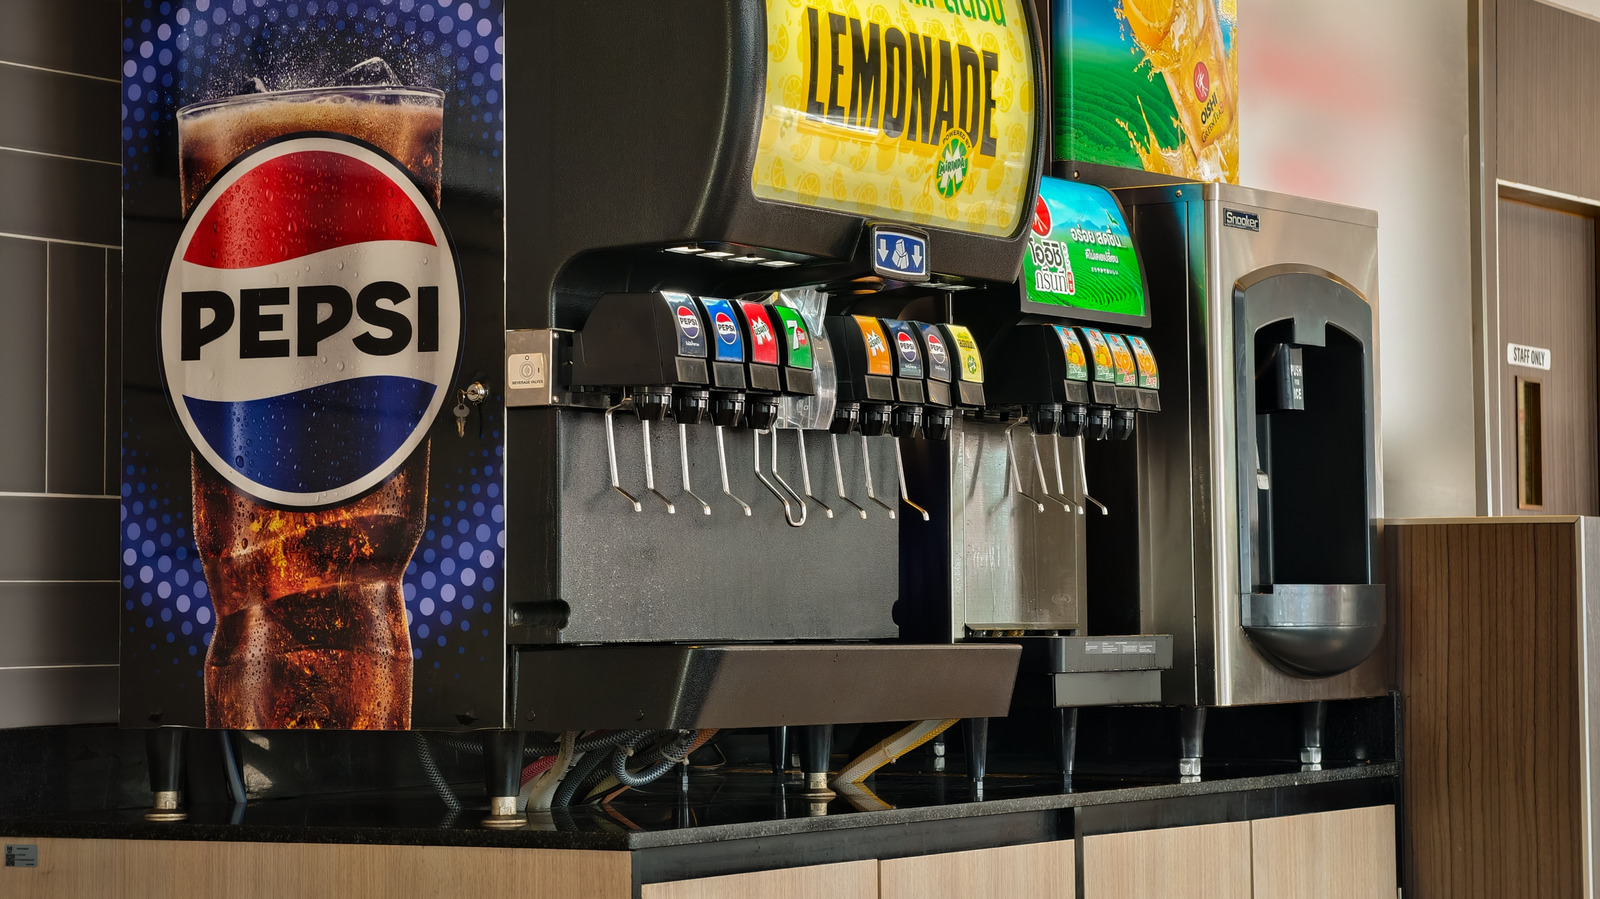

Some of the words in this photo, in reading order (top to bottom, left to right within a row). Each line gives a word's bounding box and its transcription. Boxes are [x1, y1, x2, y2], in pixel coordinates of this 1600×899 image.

[805, 7, 998, 158] LEMONADE
[1200, 92, 1218, 125] OISHI
[942, 130, 966, 144] POWERED
[1226, 211, 1259, 228] Snooker
[1070, 223, 1095, 244] อร่อย
[1028, 237, 1063, 267] โออิชิ
[181, 281, 440, 361] PEPSI
[679, 317, 698, 326] PEPSI
[717, 323, 735, 333] PEPSI
[899, 342, 915, 351] PEPSI
[929, 343, 944, 352] PEPSI
[1513, 346, 1530, 364] STAFF
[1530, 350, 1545, 367] ONLY
[1290, 364, 1302, 377] PUSH
[1294, 388, 1302, 400] ICE
